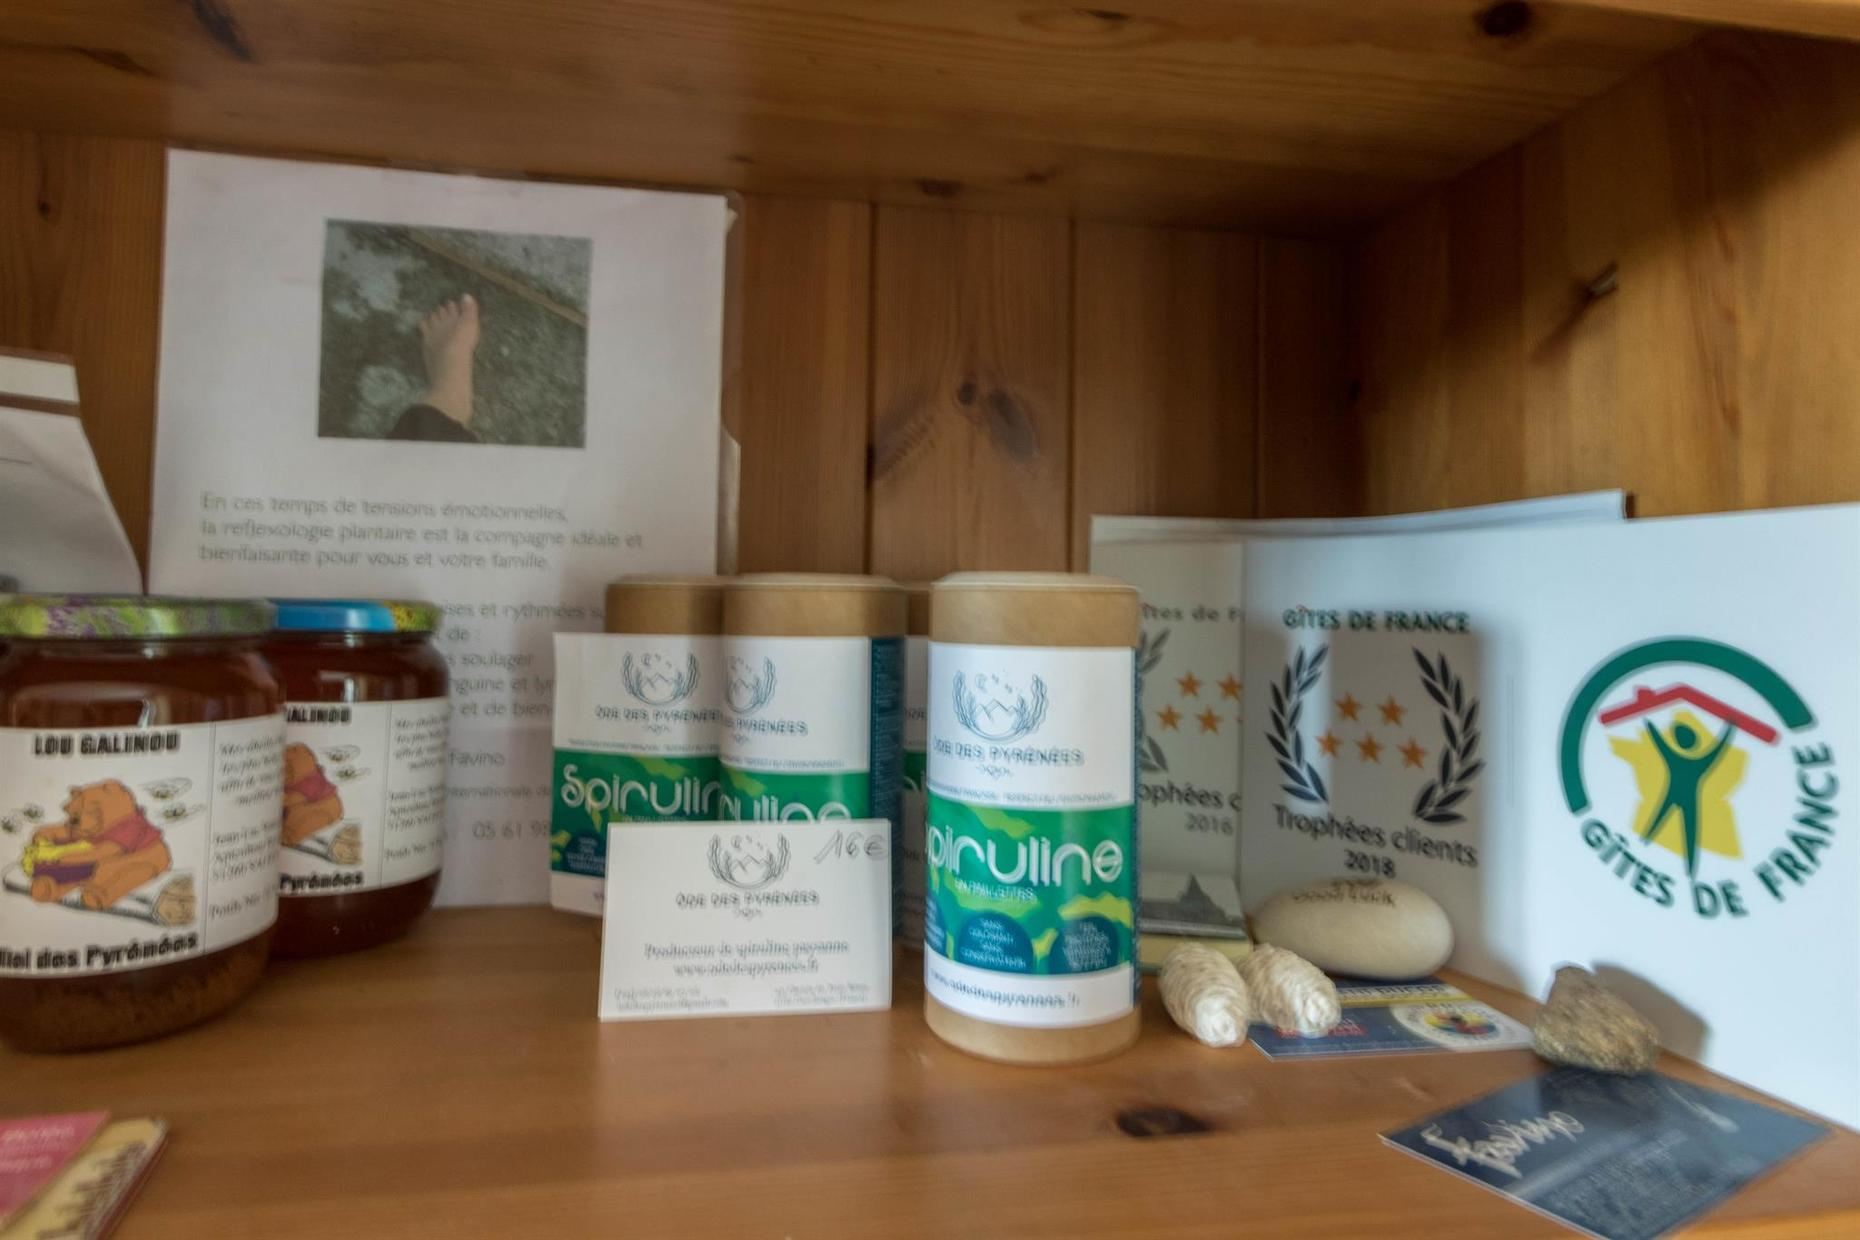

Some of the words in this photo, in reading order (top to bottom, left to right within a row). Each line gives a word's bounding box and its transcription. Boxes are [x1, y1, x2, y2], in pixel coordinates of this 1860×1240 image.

[202, 491, 226, 512] En
[232, 497, 264, 512] ces
[269, 496, 329, 519] temps
[334, 496, 356, 514] de
[362, 498, 435, 518] tensions
[201, 519, 217, 536] la
[340, 522, 418, 544] plantaire
[423, 526, 450, 544] est
[456, 526, 470, 545] la
[474, 530, 566, 549] compagne
[624, 531, 643, 548] et
[200, 542, 311, 564] bienfaisante
[317, 549, 362, 569] pour
[367, 551, 410, 568] vous
[414, 551, 433, 568] et
[439, 552, 486, 569] votre
[479, 603, 498, 617] et
[1347, 609, 1376, 632] DE
[1383, 609, 1471, 634] FRANCE
[448, 625, 471, 642] de
[461, 649, 534, 673] soulager
[511, 675, 529, 691] et
[287, 707, 352, 724] ALINOU
[459, 700, 478, 716] et
[484, 697, 508, 717] de
[34, 732, 75, 756] LOU
[80, 731, 181, 756] GALINOU
[561, 764, 722, 816] Spirulin
[1271, 802, 1387, 848] Trophées
[1392, 825, 1479, 868] clients
[1692, 879, 1749, 920] DE
[1754, 742, 1841, 903] FRANCE
[813, 829, 889, 866] 16€
[926, 825, 1124, 888] piruline
[1343, 849, 1397, 880] 2018
[675, 891, 707, 908] ODE
[711, 890, 740, 908] DES
[36, 944, 79, 970] des
[86, 931, 199, 973] Pyrénées
